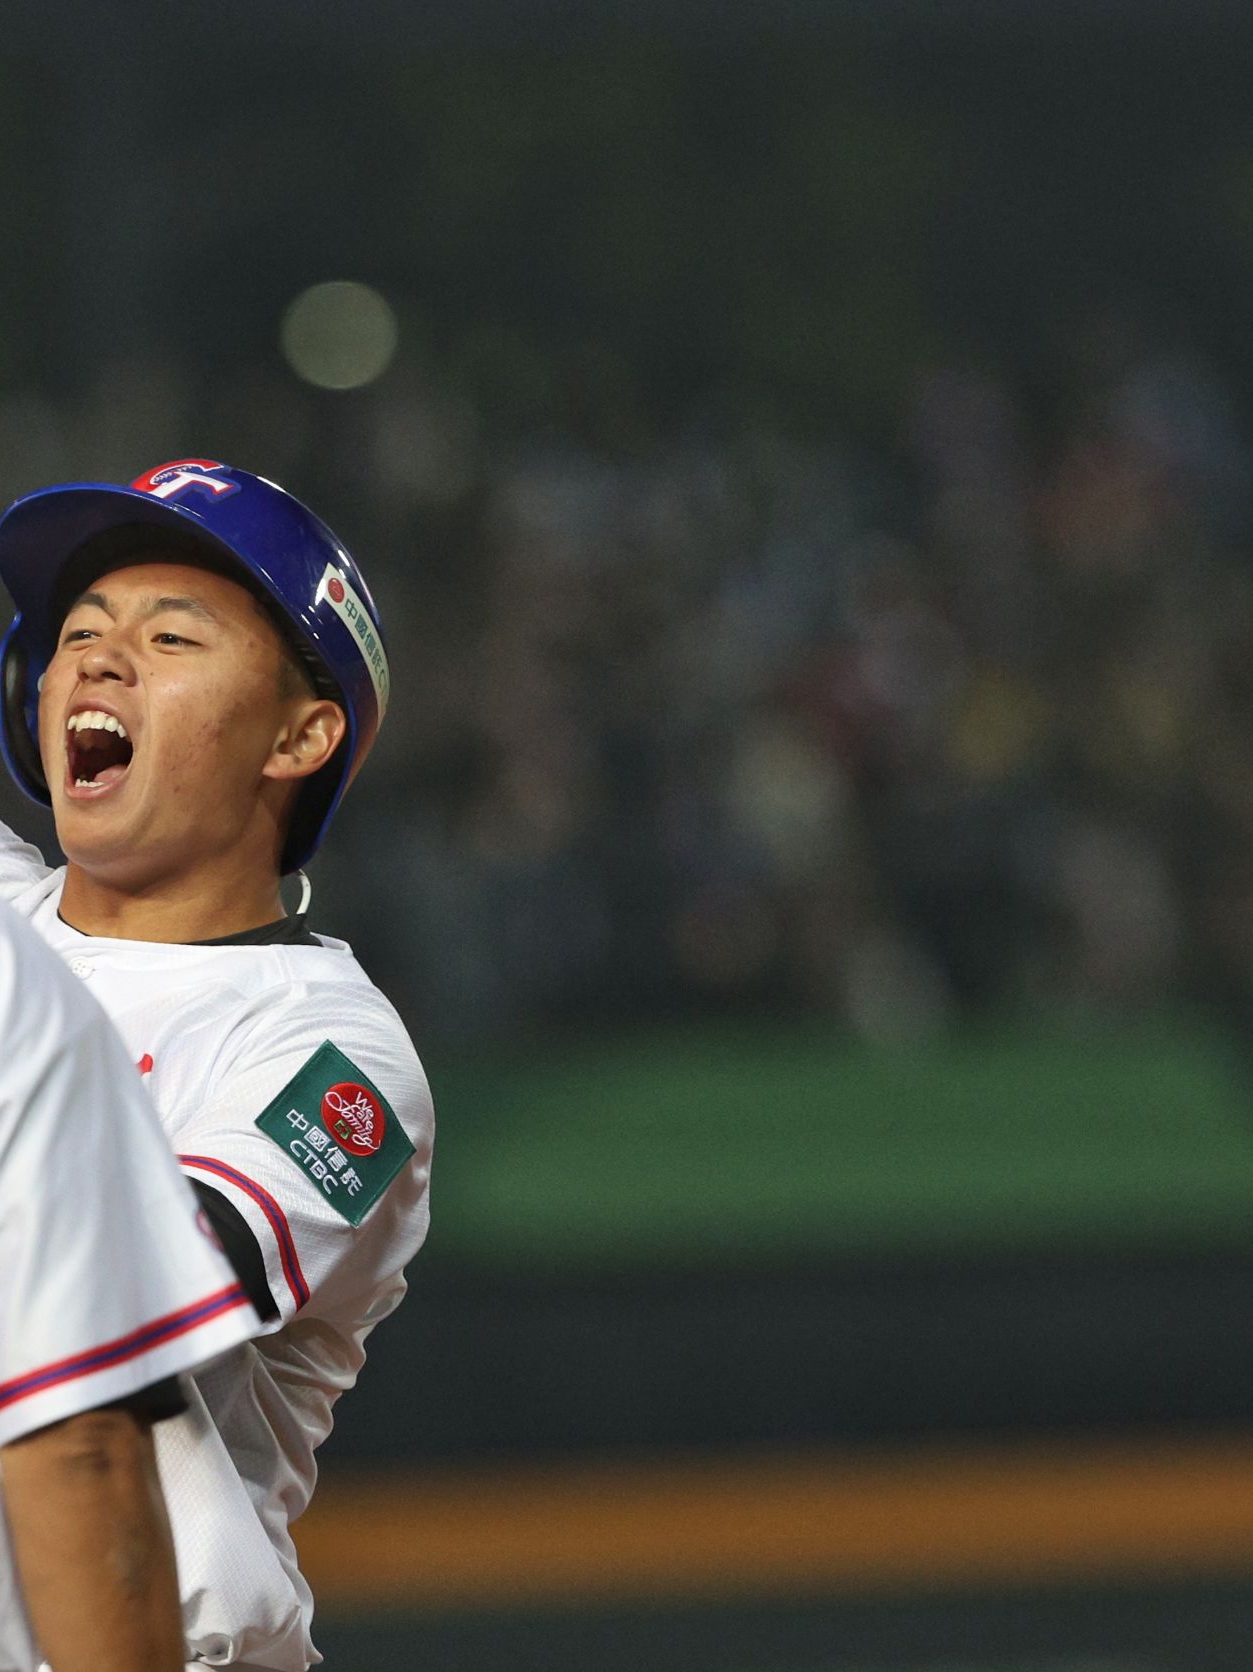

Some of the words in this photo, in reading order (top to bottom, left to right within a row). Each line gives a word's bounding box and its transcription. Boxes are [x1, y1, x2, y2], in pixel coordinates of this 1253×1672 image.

[355, 1091, 374, 1119] We
[285, 1108, 364, 1197] 中國信託
[289, 1139, 339, 1195] CTBC
